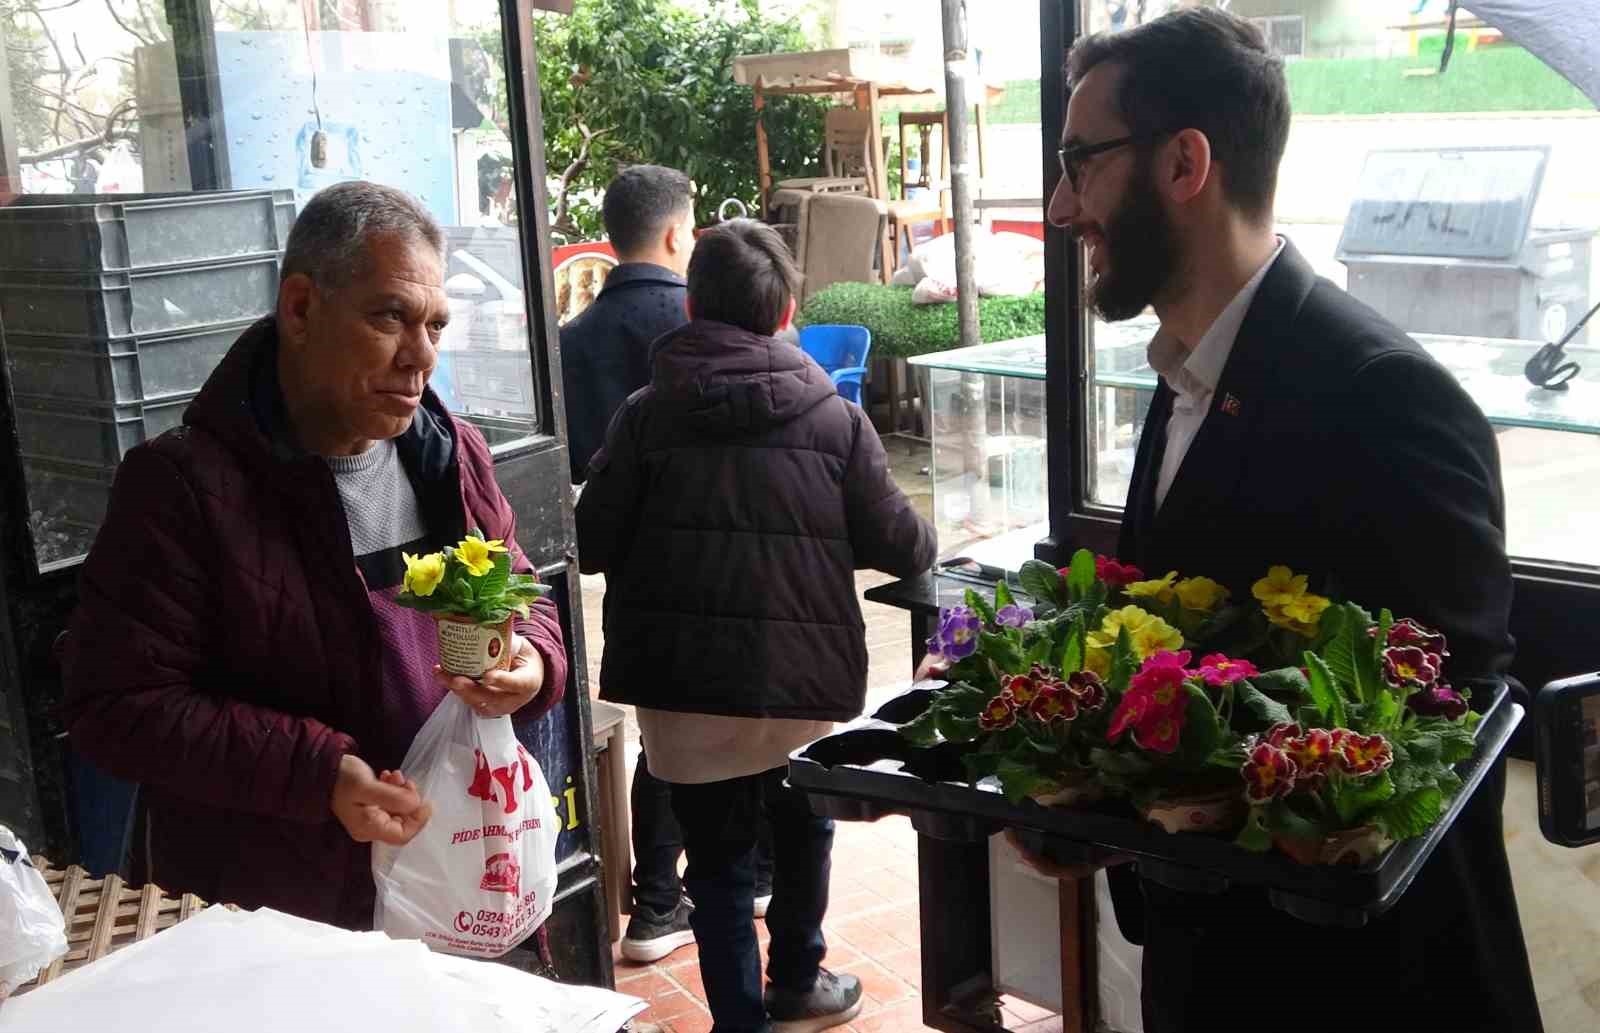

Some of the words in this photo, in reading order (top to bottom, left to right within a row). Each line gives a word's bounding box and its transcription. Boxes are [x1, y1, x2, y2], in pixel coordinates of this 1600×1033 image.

[477, 910, 504, 923] 0324
[524, 891, 536, 906] 80
[472, 925, 500, 938] 0543
